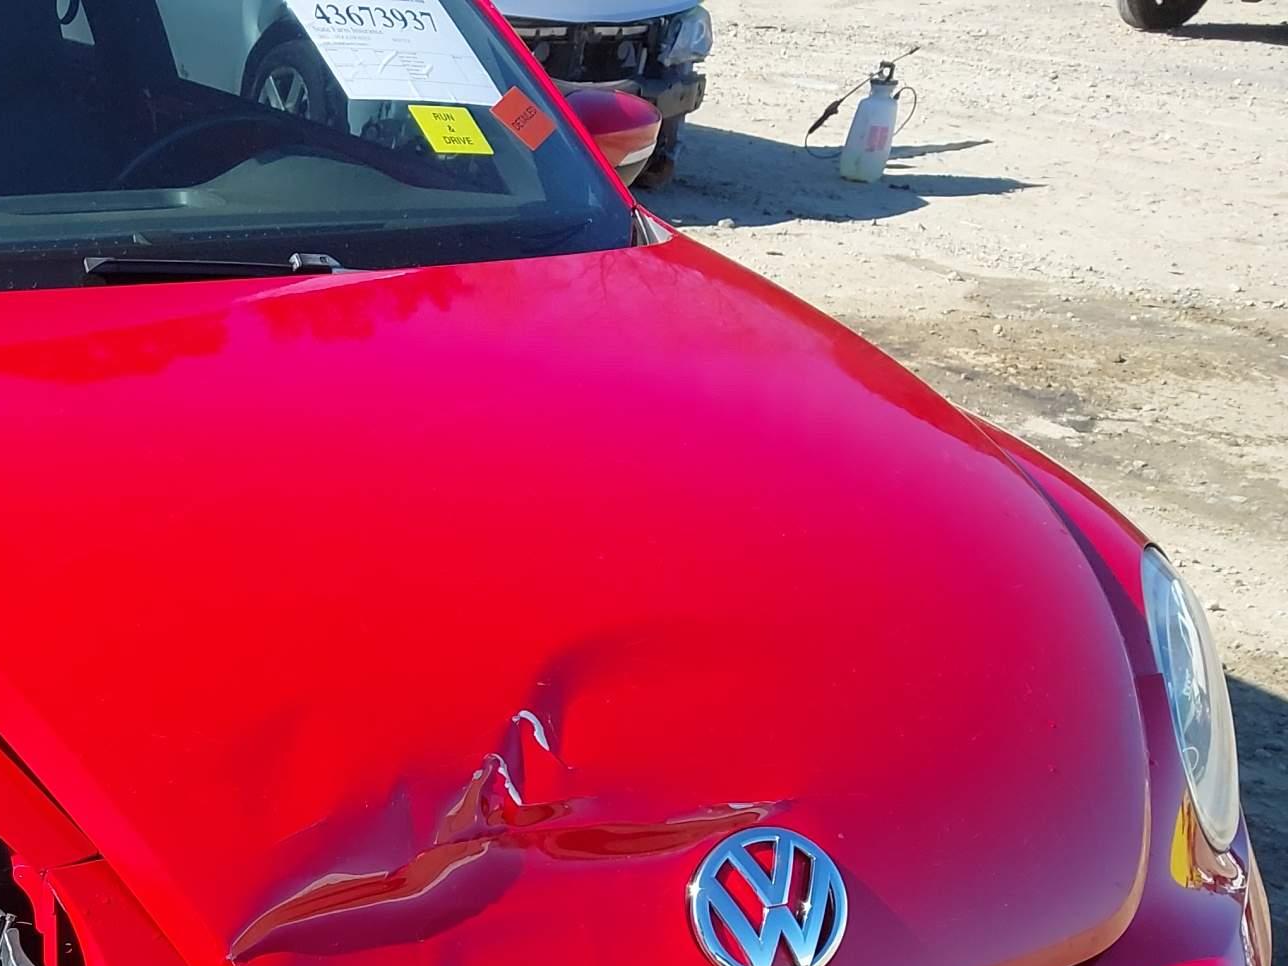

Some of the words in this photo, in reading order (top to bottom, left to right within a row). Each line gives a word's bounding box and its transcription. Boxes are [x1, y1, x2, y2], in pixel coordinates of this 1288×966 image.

[314, 3, 437, 32] 43673937
[432, 112, 455, 122] RUN
[512, 106, 537, 131] DETAILED
[447, 124, 456, 133] &
[443, 135, 474, 146] DRIVE
